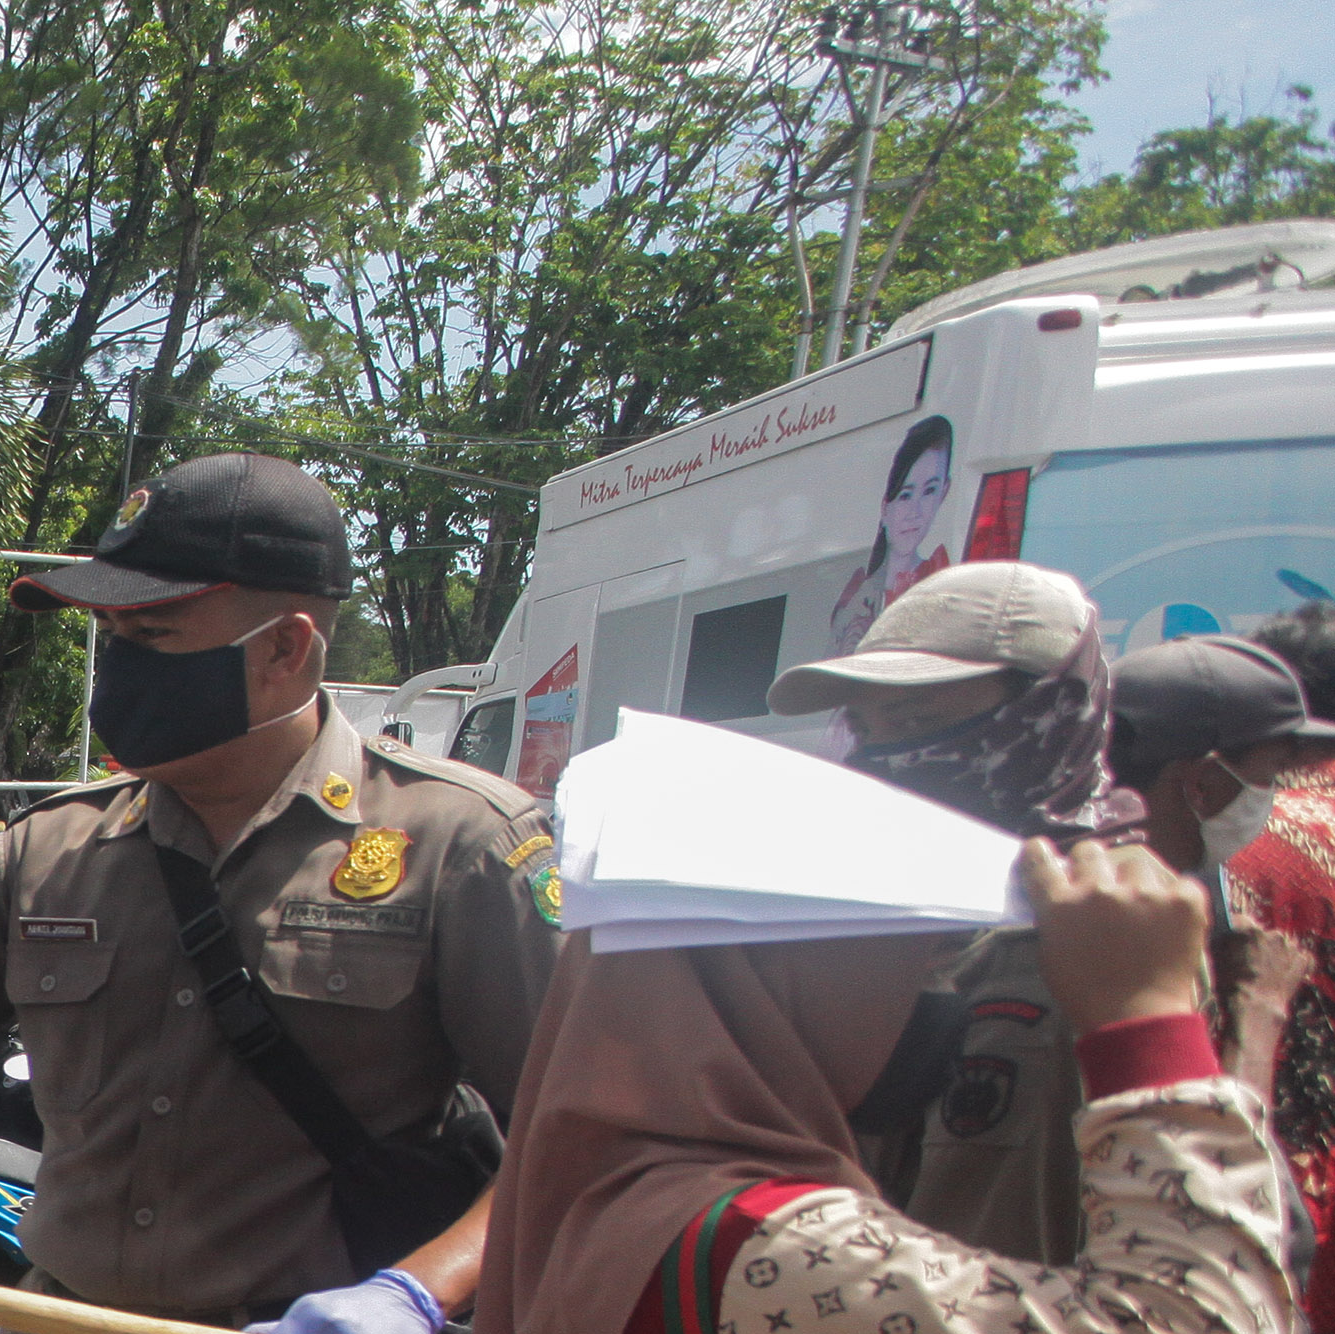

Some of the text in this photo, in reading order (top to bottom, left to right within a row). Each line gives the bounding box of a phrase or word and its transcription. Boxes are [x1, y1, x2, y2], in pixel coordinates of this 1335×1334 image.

[580, 402, 837, 508] Mitra Terpercaya Meraih Sukses
